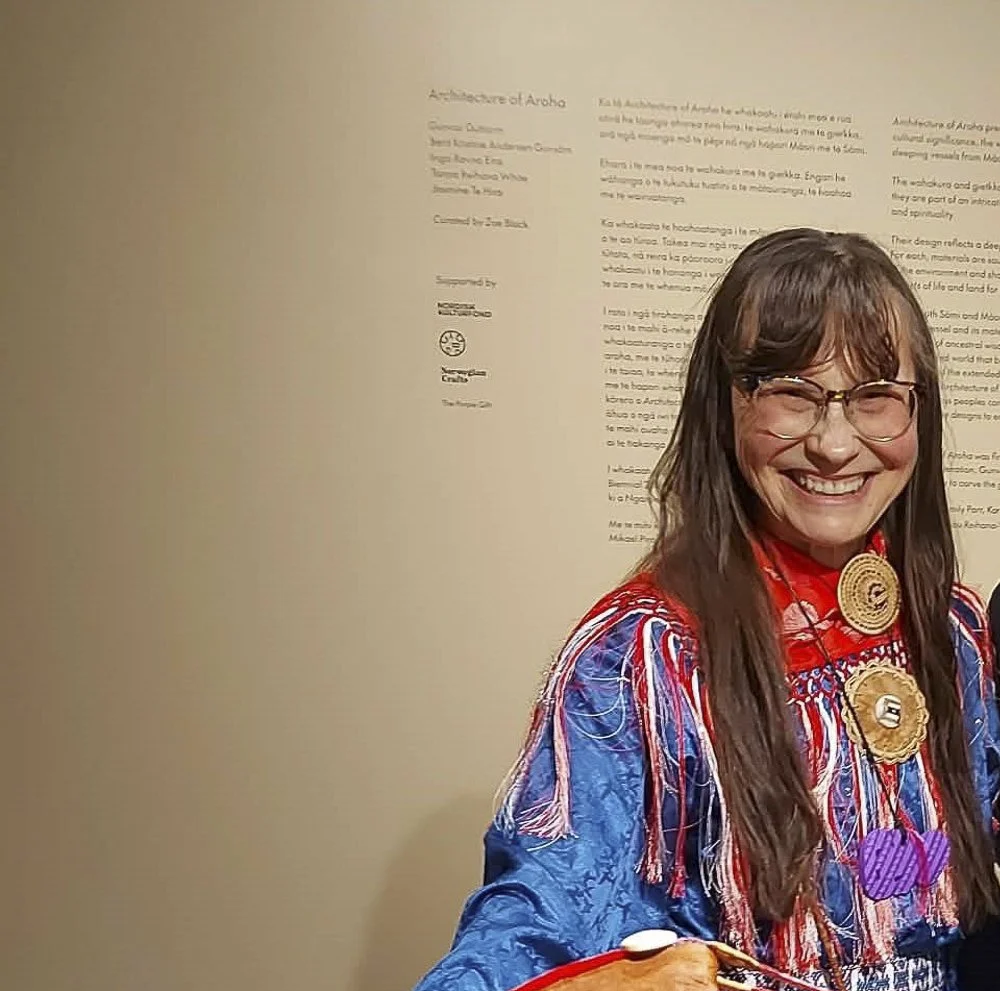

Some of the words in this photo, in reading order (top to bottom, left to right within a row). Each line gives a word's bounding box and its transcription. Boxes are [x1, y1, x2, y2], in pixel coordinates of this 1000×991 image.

[956, 120, 984, 131] Aroha
[914, 236, 942, 249] design
[970, 269, 985, 278] and
[948, 283, 964, 292] and
[966, 283, 985, 293] land
